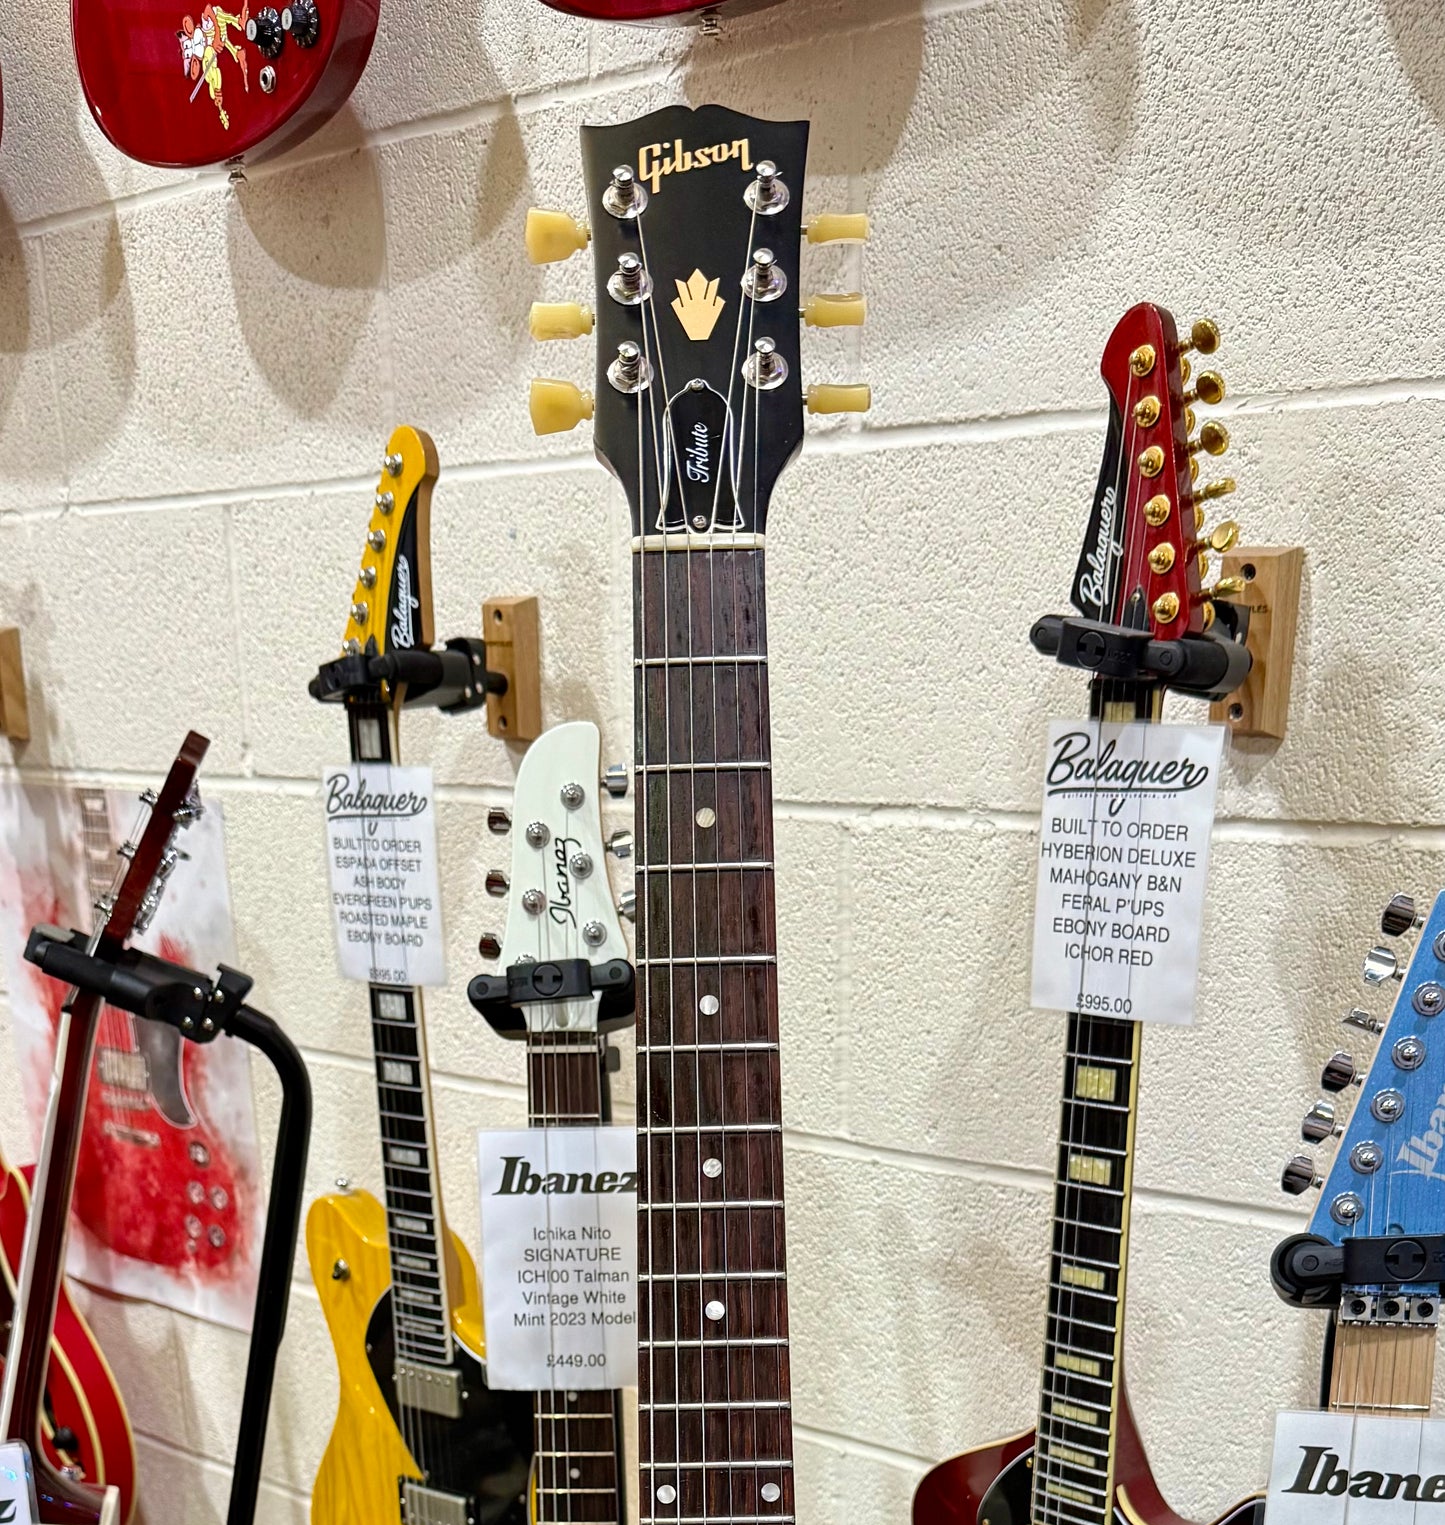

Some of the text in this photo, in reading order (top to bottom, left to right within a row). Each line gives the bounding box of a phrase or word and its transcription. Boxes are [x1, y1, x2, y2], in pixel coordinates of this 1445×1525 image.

[638, 138, 754, 194] Gibson
[685, 421, 710, 483] Tribute
[1079, 486, 1124, 607] Balaguer
[391, 554, 419, 649] Balaguer
[1047, 732, 1209, 817] Balaguer
[326, 773, 428, 836] Balaguer
[1051, 818, 1188, 842] BUILT TO ORDER
[333, 837, 422, 853] BUILT TO ORDER
[1041, 842, 1196, 868] HYBERION DELUXE
[336, 856, 422, 872] ESPADA OFFSET
[354, 875, 407, 890] ASH BODY
[549, 837, 582, 929] Ibanez
[1050, 867, 1182, 893] MAHOGANY B&N
[332, 892, 397, 908] EVERGREEN
[1062, 893, 1164, 917] FERAL P'UPS
[339, 911, 428, 929] ROASTED MAPLE
[1053, 917, 1170, 943] EBONY BOARD
[347, 930, 424, 947] EBONY BOARD
[1065, 942, 1153, 966] ICHOR RED
[1076, 992, 1132, 1014] £995.00
[492, 1156, 637, 1196] Ibanez
[533, 1227, 612, 1241] Ichika Nito
[523, 1247, 622, 1262] SIGNATURE
[574, 1269, 629, 1284] Talman
[522, 1291, 626, 1308] Vintage White
[513, 1311, 636, 1327] Mint 2023 Model
[546, 1353, 606, 1368] £449.00
